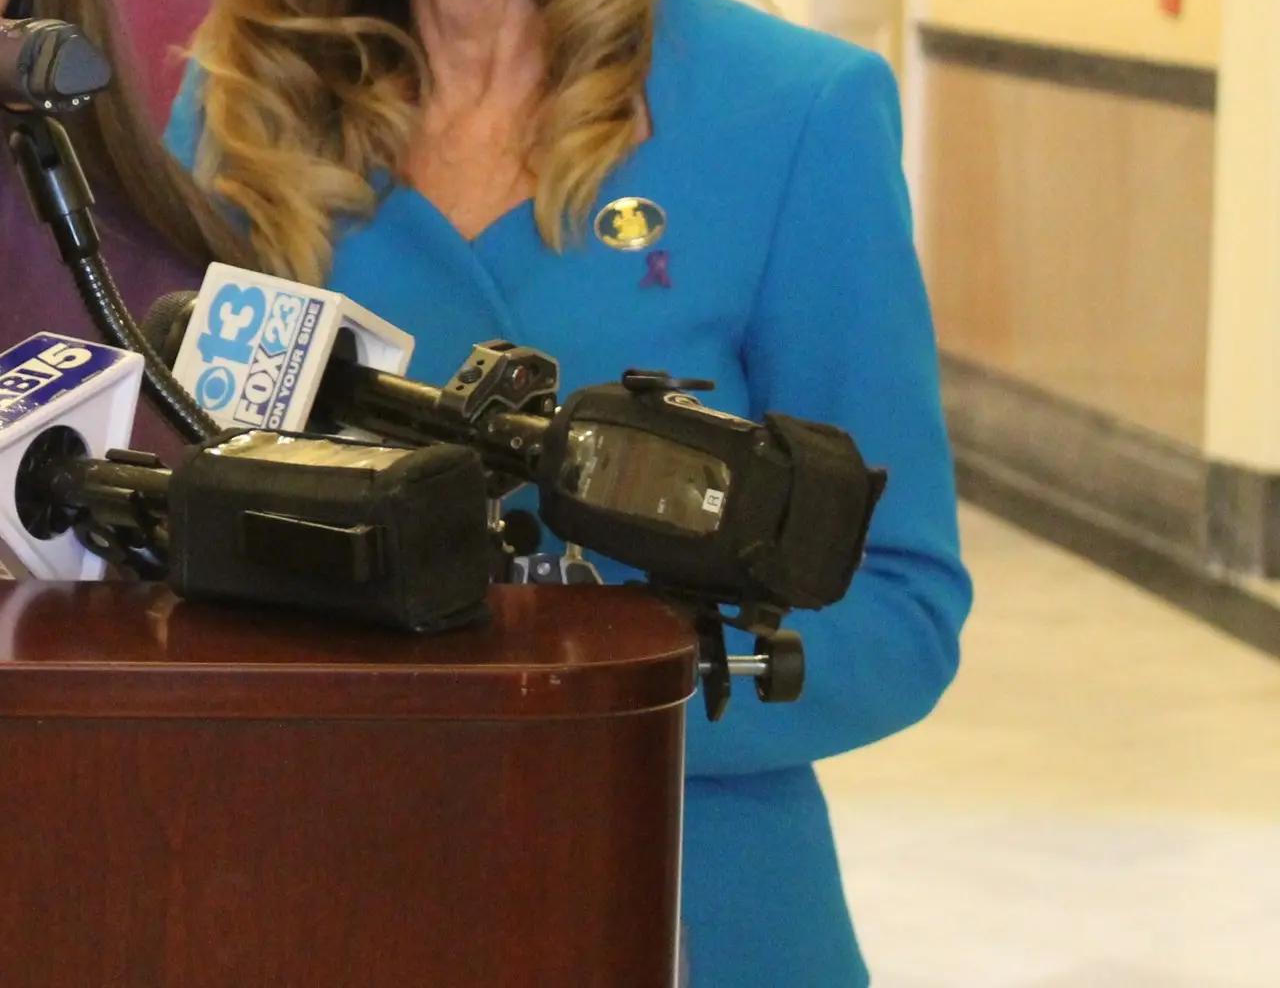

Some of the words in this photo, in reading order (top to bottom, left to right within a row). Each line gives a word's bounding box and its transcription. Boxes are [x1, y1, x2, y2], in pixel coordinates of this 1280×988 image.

[197, 283, 266, 363] 13
[237, 348, 288, 425] FOX
[269, 295, 300, 346] 23
[270, 405, 286, 429] ON
[280, 348, 305, 399] YOUR
[297, 302, 321, 345] SIDE
